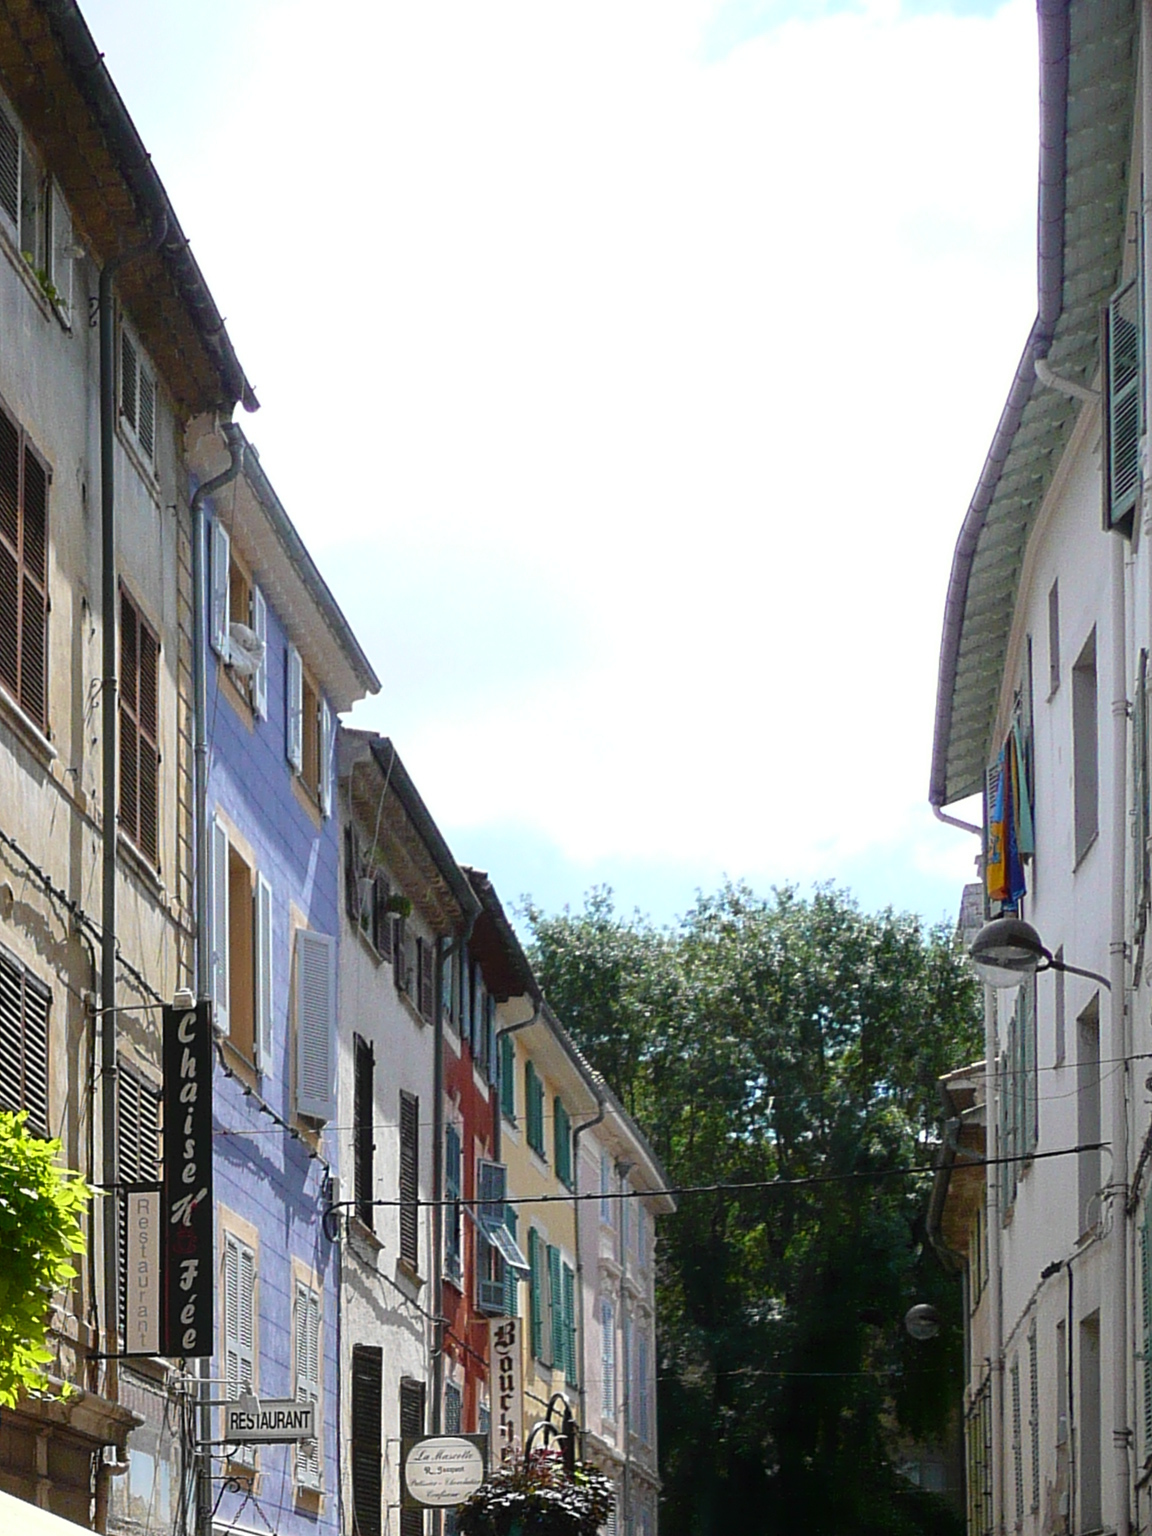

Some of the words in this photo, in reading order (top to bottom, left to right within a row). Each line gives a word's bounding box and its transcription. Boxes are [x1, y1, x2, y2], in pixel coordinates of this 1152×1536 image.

[176, 1011, 198, 1184] Chaise
[136, 1198, 150, 1347] Restaurant
[230, 1410, 311, 1431] RESTAURANT
